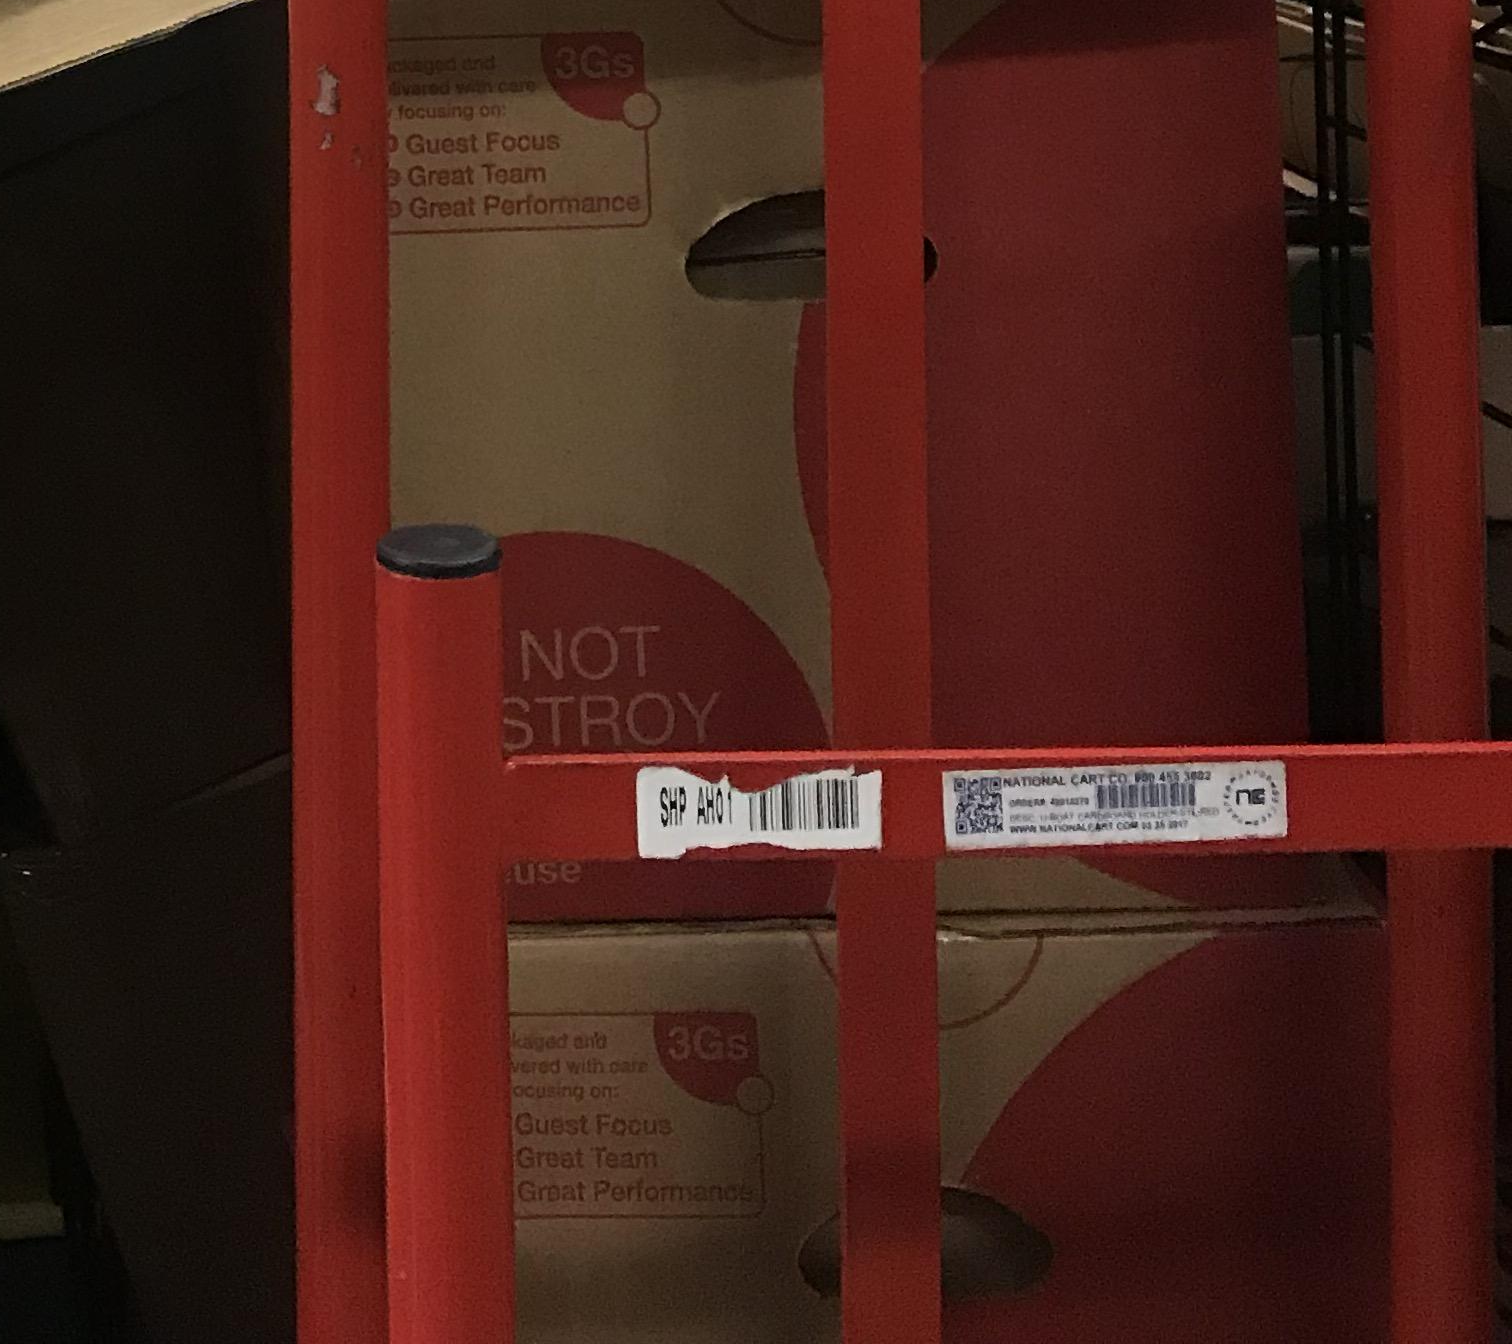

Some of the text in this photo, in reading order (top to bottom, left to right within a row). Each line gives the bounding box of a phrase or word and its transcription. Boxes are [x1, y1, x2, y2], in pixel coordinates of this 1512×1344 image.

[553, 44, 635, 80] 3Gs
[455, 80, 536, 95] with care
[399, 103, 474, 121] focusing
[406, 132, 561, 155] Guest Focus
[407, 163, 547, 188] Great Team
[409, 193, 640, 219] Great Performance
[519, 626, 661, 682] NOT
[502, 691, 723, 751] STROY
[1003, 775, 1065, 787] NATIONAL
[1071, 772, 1103, 785] CART
[660, 786, 686, 827] SHP
[573, 1032, 607, 1050] and
[667, 1024, 750, 1061] 3Gs
[566, 1058, 649, 1074] with care
[513, 1084, 584, 1102] ocusing
[515, 1113, 673, 1136] Guest Focus
[516, 1146, 658, 1169] Great Team
[517, 1179, 754, 1203] Great Performance
